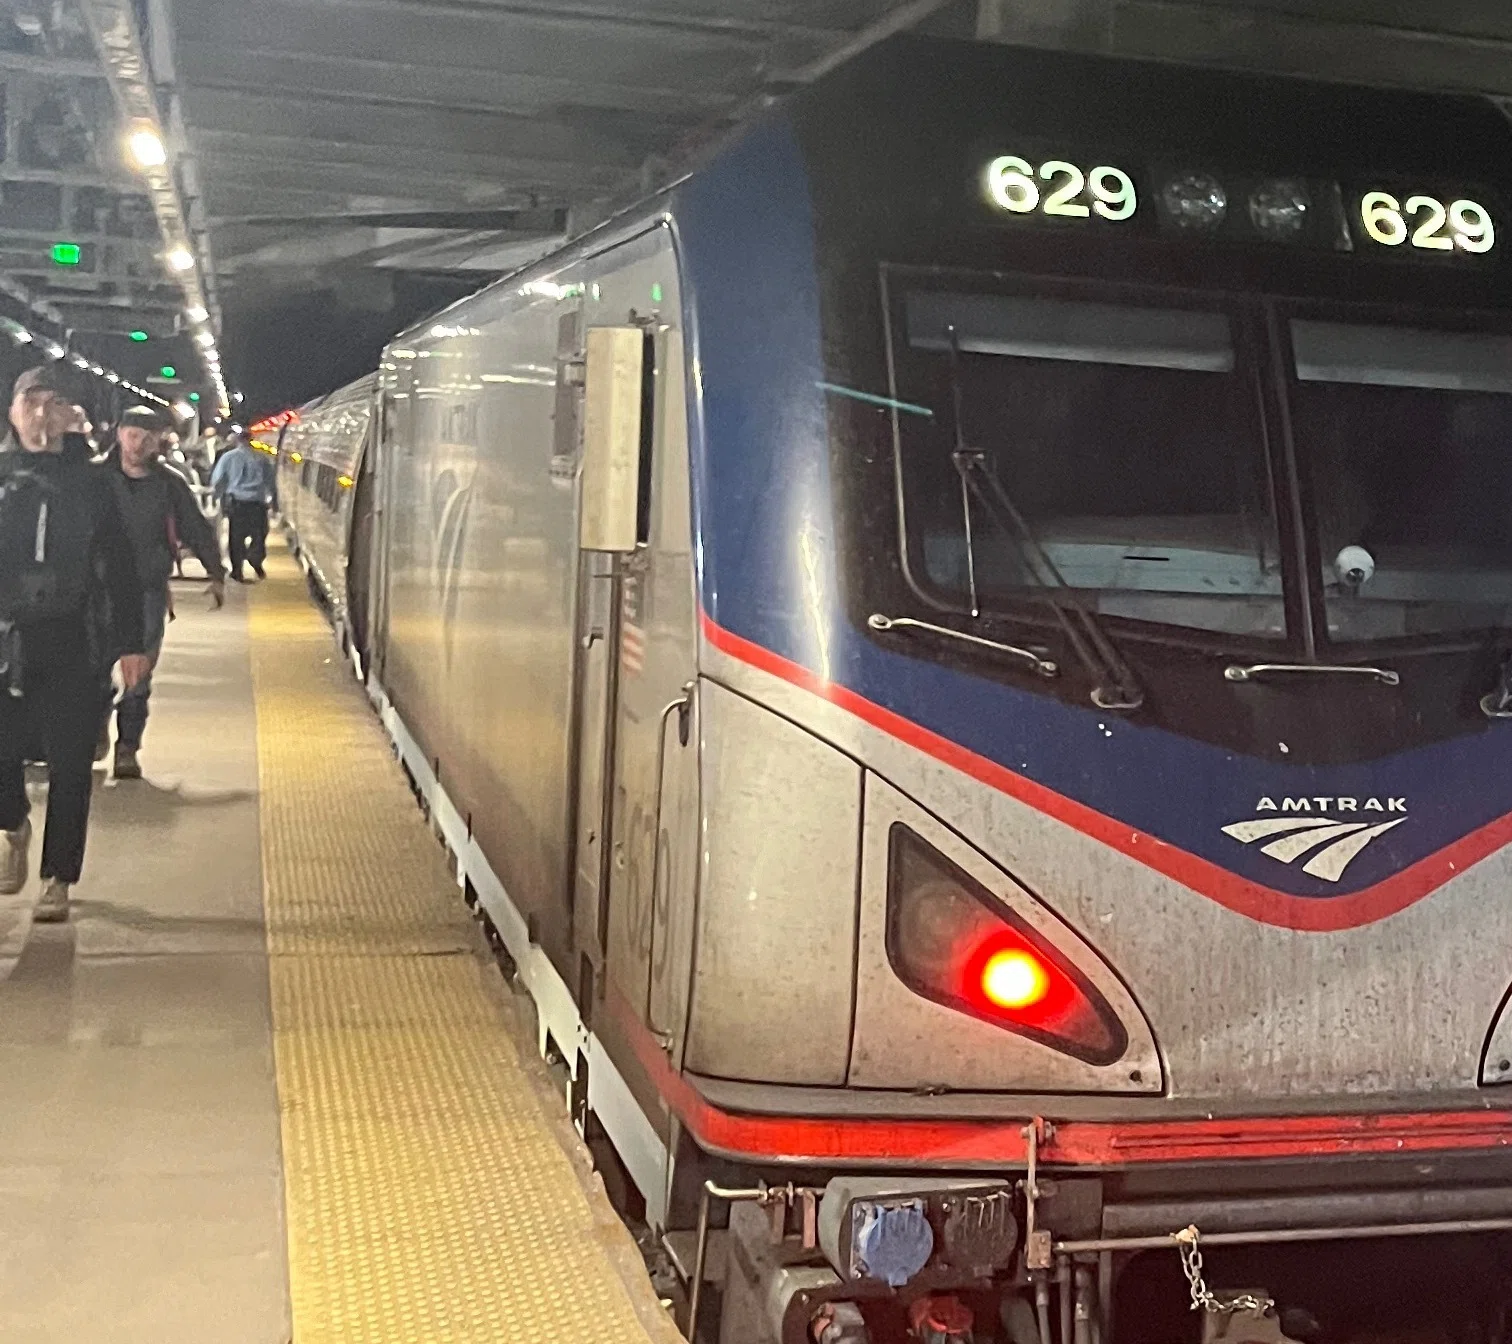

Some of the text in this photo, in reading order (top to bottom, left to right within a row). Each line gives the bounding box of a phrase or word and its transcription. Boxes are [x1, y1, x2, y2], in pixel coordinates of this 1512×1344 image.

[986, 155, 1137, 221] 629
[1360, 191, 1495, 253] 629
[1255, 796, 1407, 813] AMTRAK
